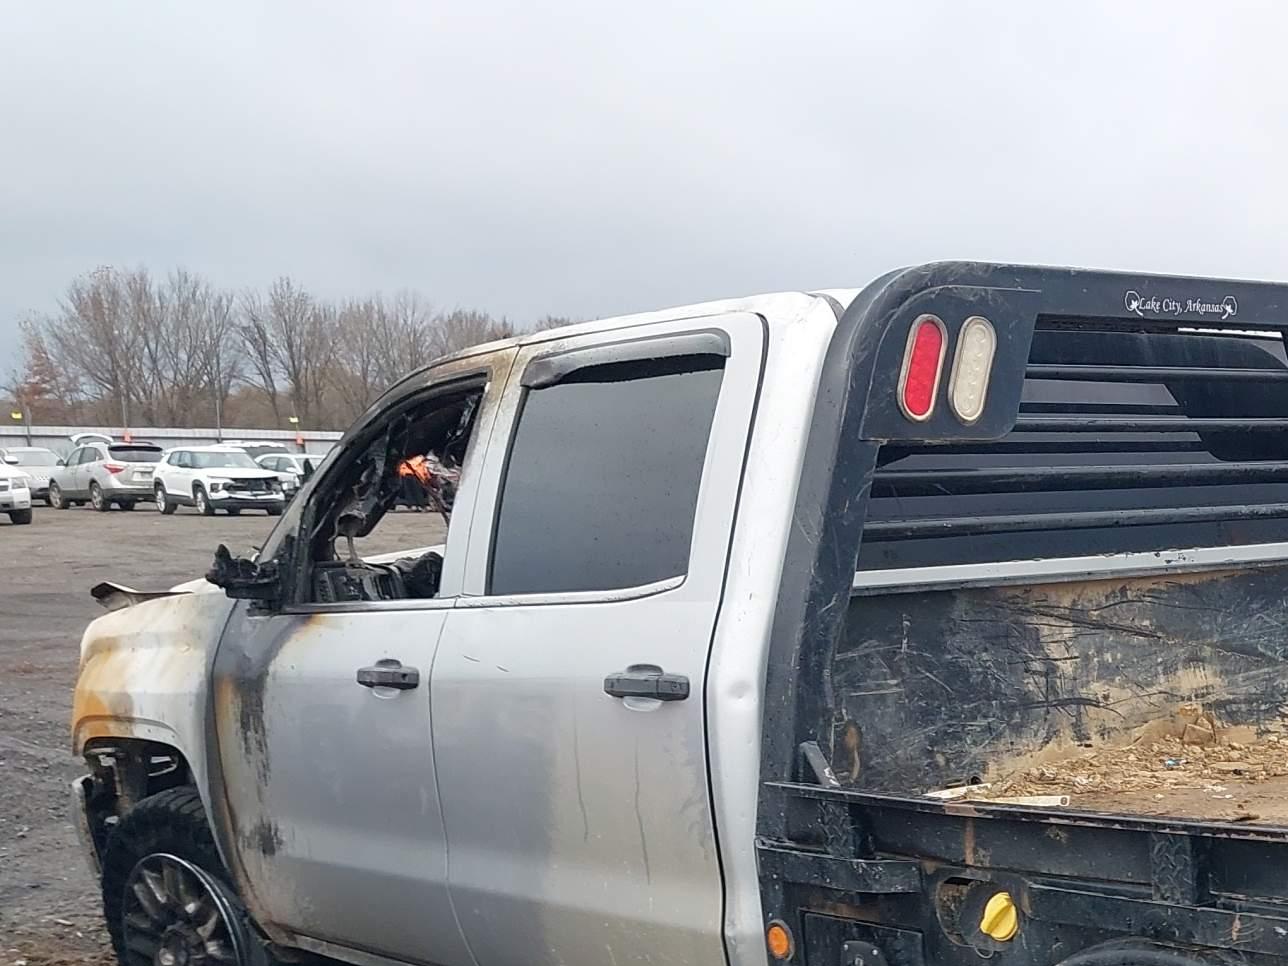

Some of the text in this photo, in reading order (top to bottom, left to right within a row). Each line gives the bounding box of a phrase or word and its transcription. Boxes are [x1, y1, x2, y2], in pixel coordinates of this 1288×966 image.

[1138, 296, 1224, 316] Lake City, Arkansas
